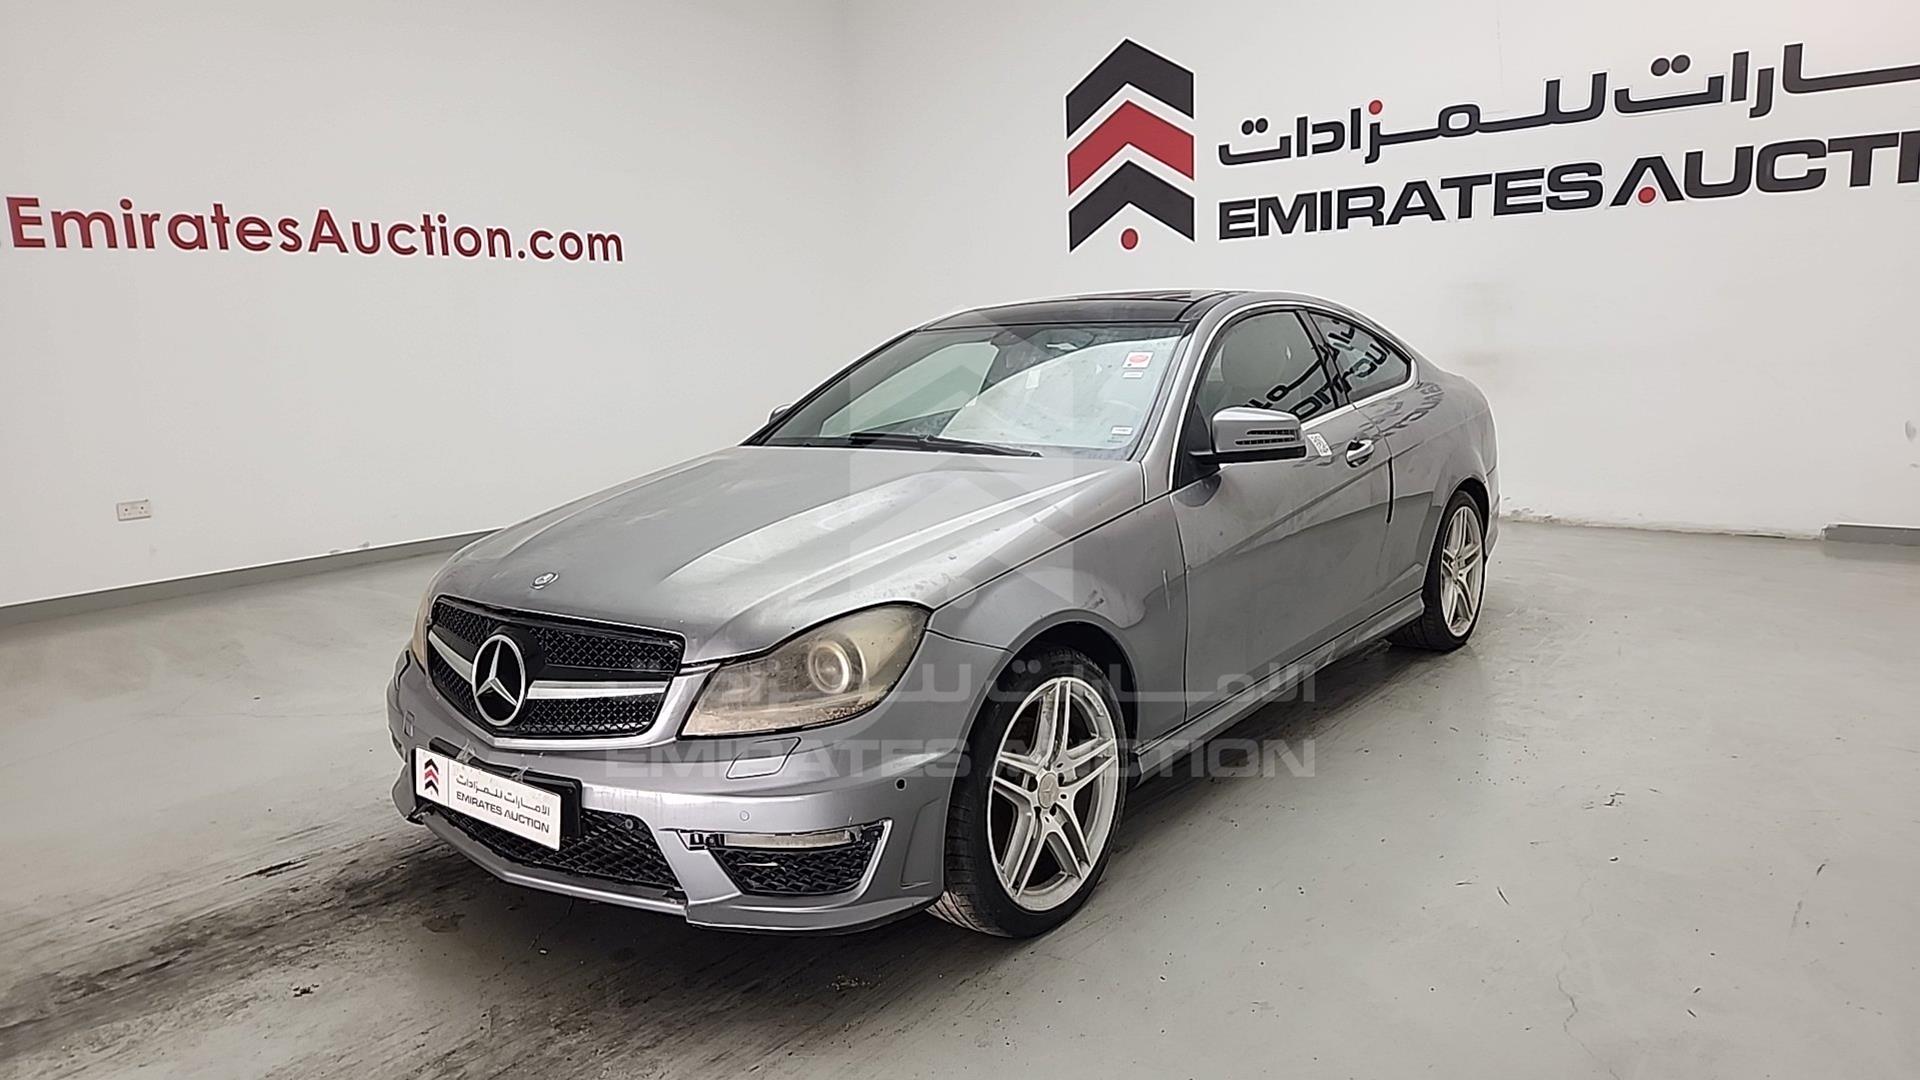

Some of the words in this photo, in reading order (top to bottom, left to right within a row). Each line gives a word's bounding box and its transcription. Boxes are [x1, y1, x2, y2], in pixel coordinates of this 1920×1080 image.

[1614, 43, 1920, 118] ارات
[1217, 72, 1607, 165] للمزادات
[1218, 162, 1602, 241] EMIRATES
[1609, 130, 1920, 207] AUCTI
[6, 196, 624, 262] EmiratesAuction.com
[456, 791, 502, 816] EMIRATES
[504, 809, 549, 834] AUCTION
